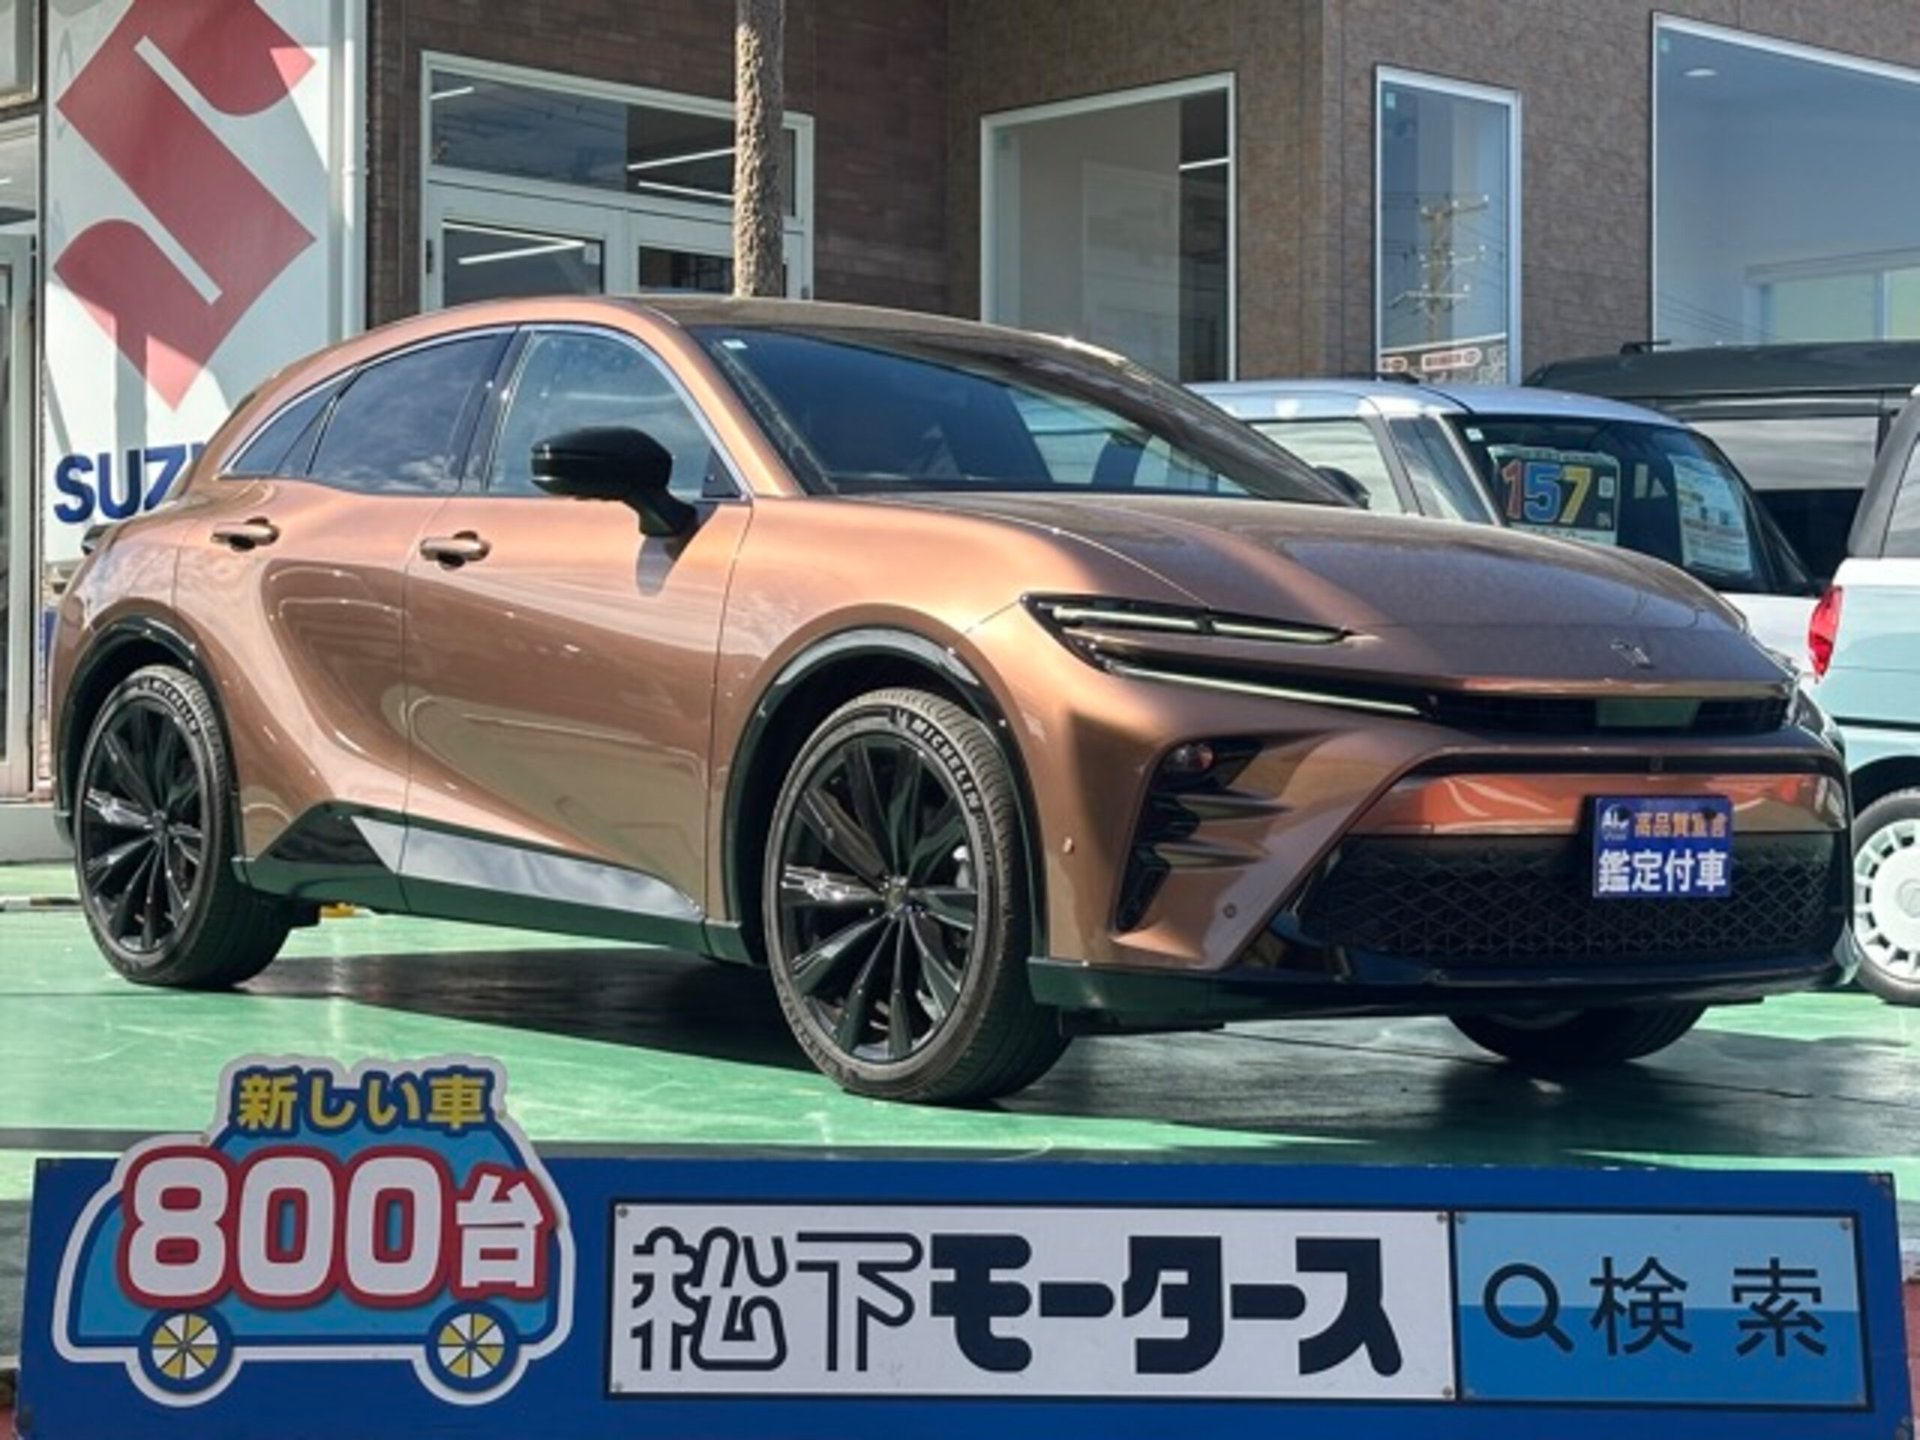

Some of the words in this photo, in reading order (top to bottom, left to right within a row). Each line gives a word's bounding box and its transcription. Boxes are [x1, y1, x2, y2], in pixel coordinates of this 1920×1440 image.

[54, 442, 205, 524] SUZ
[1502, 459, 1592, 525] 157
[911, 718, 980, 809] MICHELIN
[1598, 849, 1727, 892] 鑑定付車
[237, 1073, 488, 1130] 新しい車
[128, 1157, 543, 1297] 800台
[631, 1226, 1402, 1377] 松下モータース
[1589, 1256, 1827, 1357] 検索
